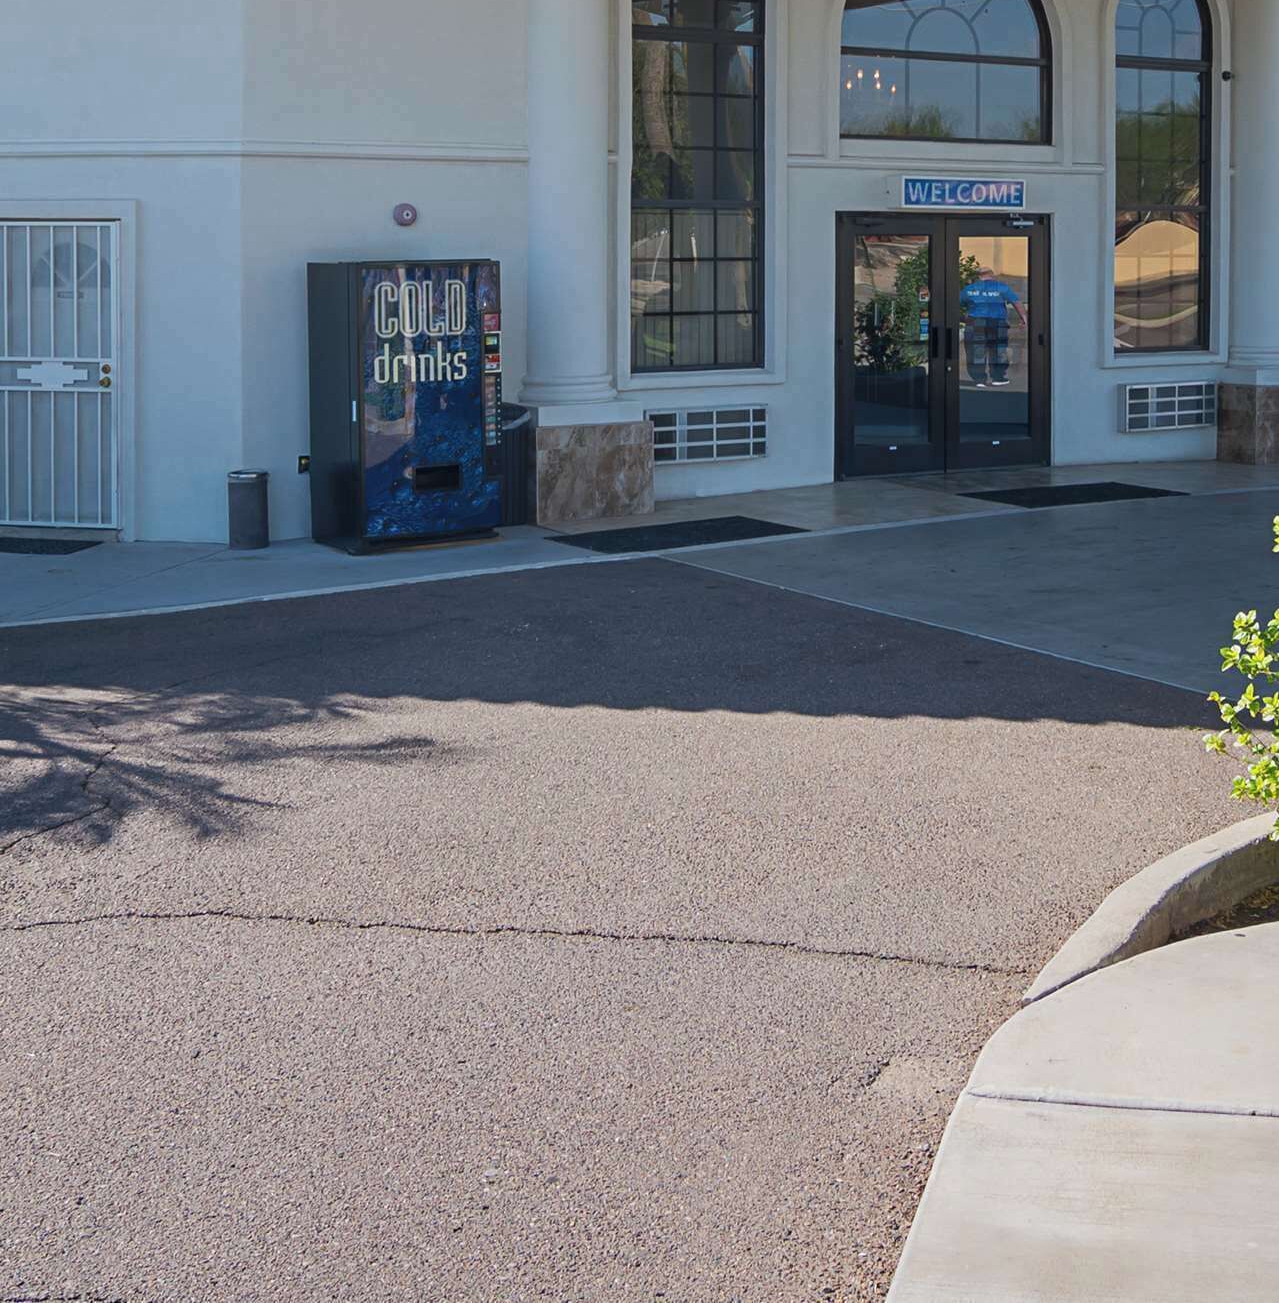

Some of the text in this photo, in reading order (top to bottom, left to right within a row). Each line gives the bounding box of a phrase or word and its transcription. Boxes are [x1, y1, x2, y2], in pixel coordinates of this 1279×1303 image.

[908, 182, 1021, 204] WELCOME
[374, 279, 467, 338] COLD
[374, 341, 467, 383] drinks
